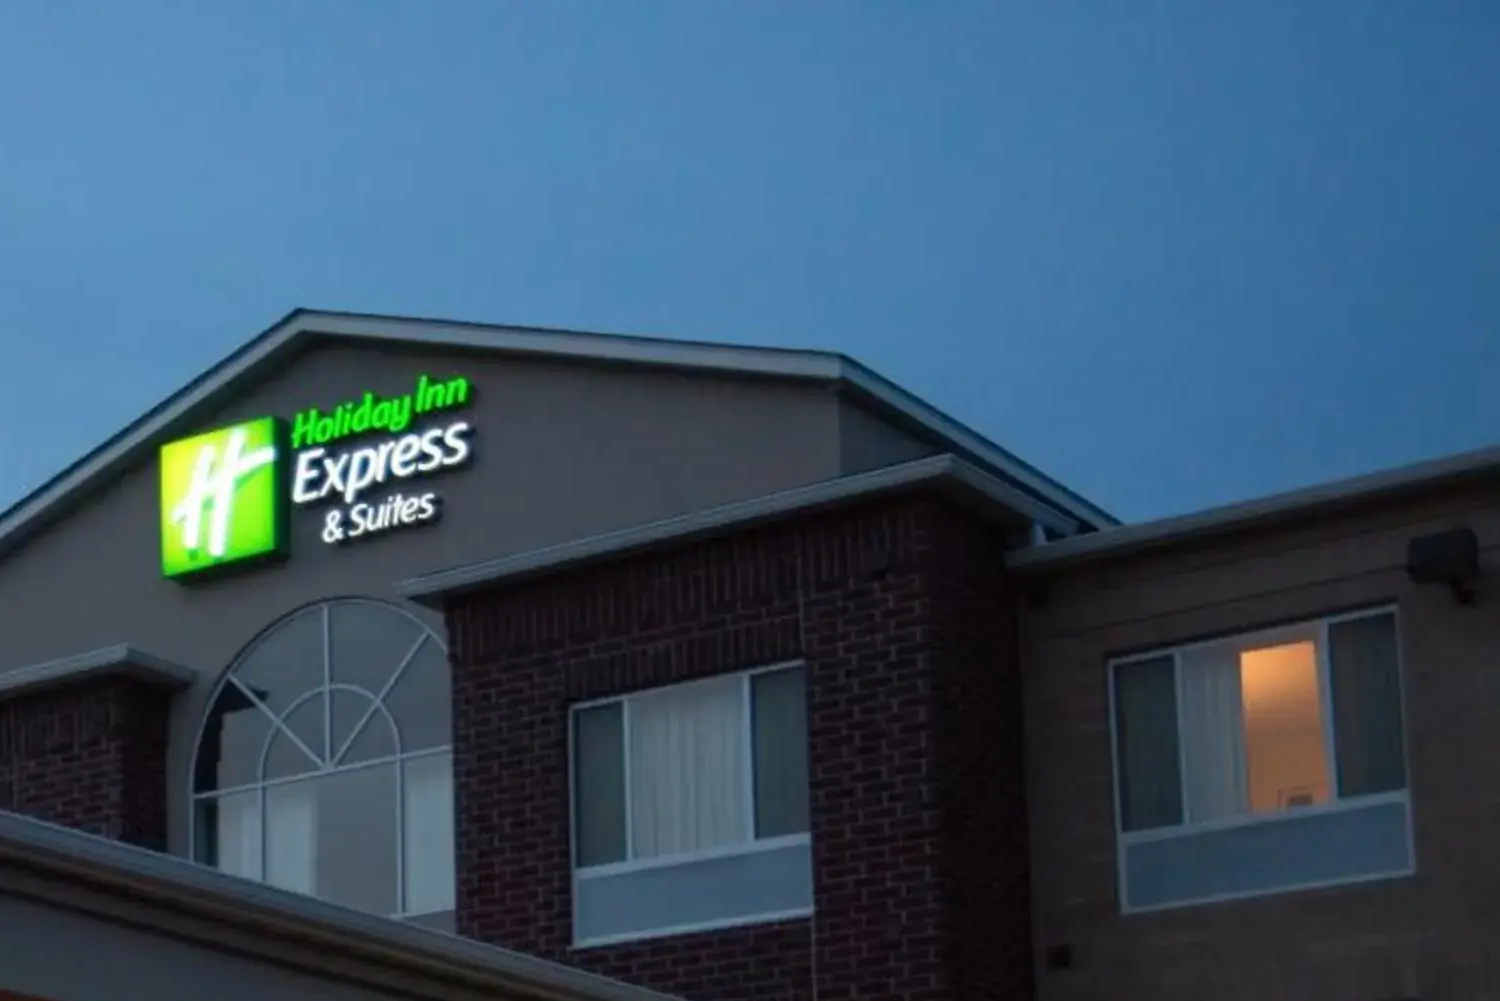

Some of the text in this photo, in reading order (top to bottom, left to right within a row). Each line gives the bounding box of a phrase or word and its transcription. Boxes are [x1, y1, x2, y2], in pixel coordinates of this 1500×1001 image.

[291, 373, 469, 448] Holiday Inn
[291, 420, 470, 504] Express
[320, 491, 436, 543] & Suites
